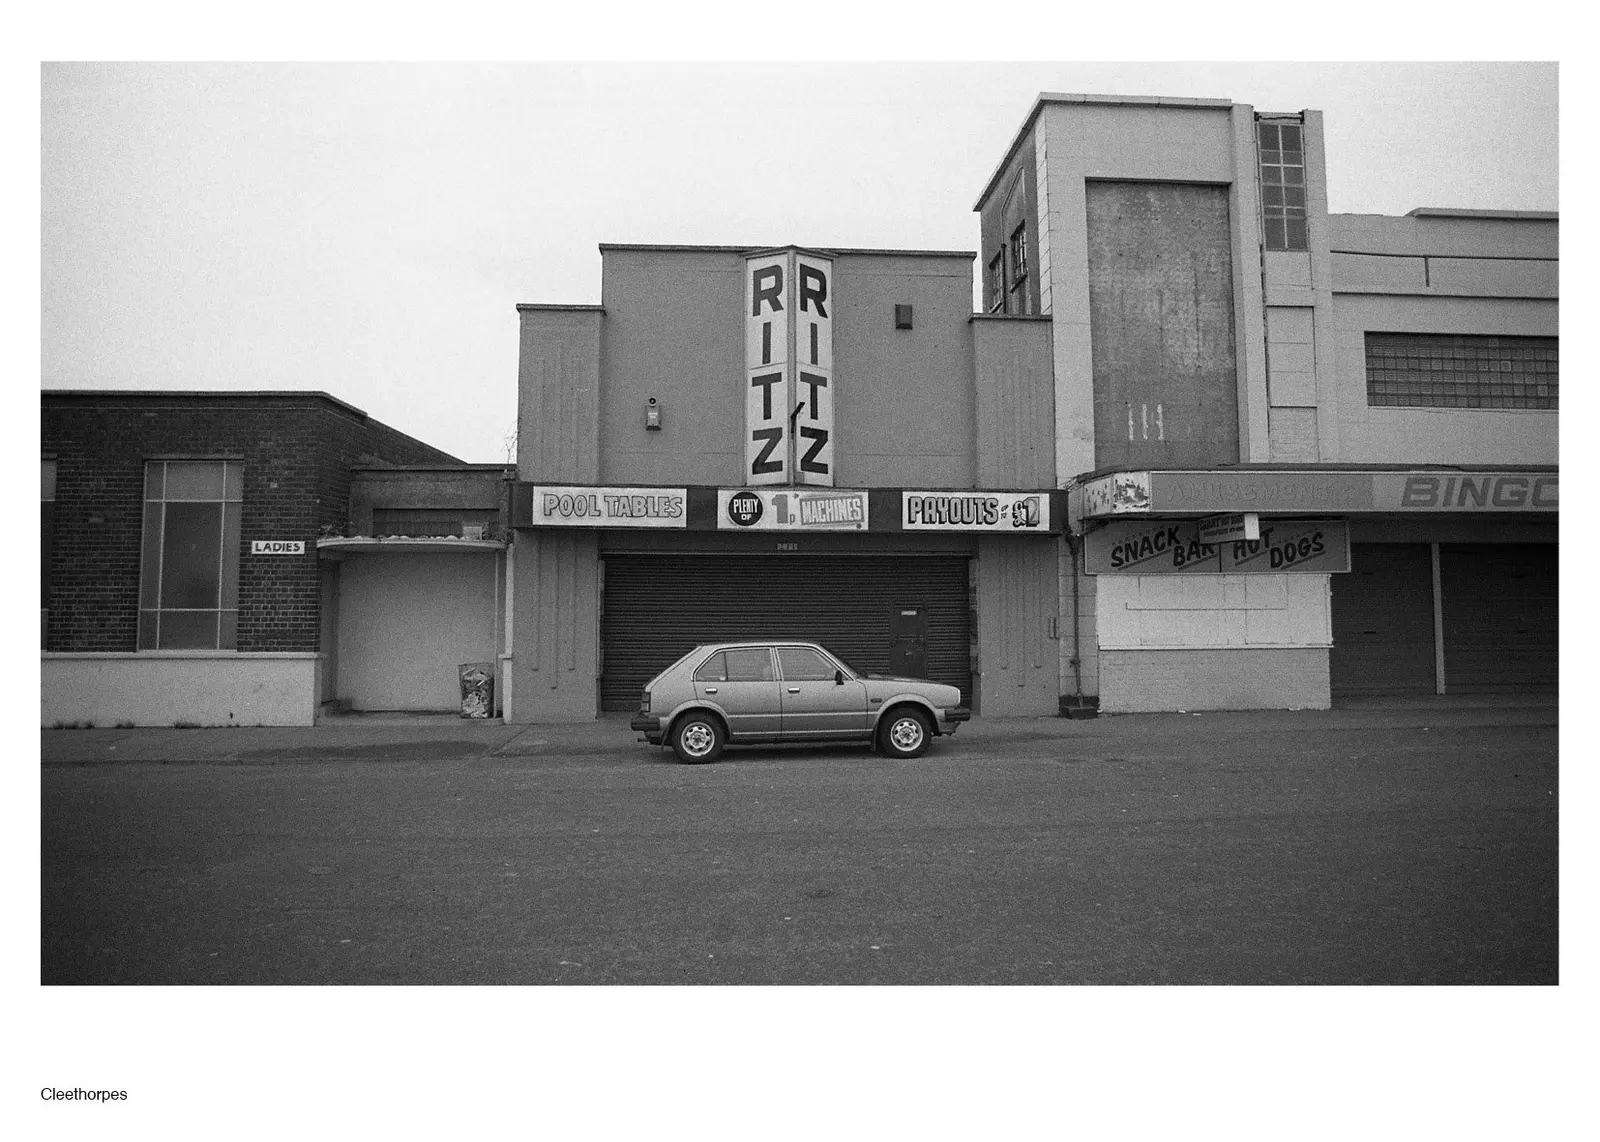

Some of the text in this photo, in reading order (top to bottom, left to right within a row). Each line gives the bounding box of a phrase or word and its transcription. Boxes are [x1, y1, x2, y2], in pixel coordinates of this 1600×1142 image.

[752, 264, 784, 475] RITZ
[799, 263, 829, 475] RITZ
[543, 493, 683, 518] POOL TABLES
[733, 498, 759, 514] PLENTY
[801, 498, 862, 524] MACHINES
[908, 496, 999, 525] PAYOUTS
[254, 542, 301, 552] LADIES
[1110, 525, 1182, 568] SNACK
[1173, 541, 1215, 567] BAR
[1233, 526, 1274, 561] HOT
[1270, 531, 1325, 569] DOGS
